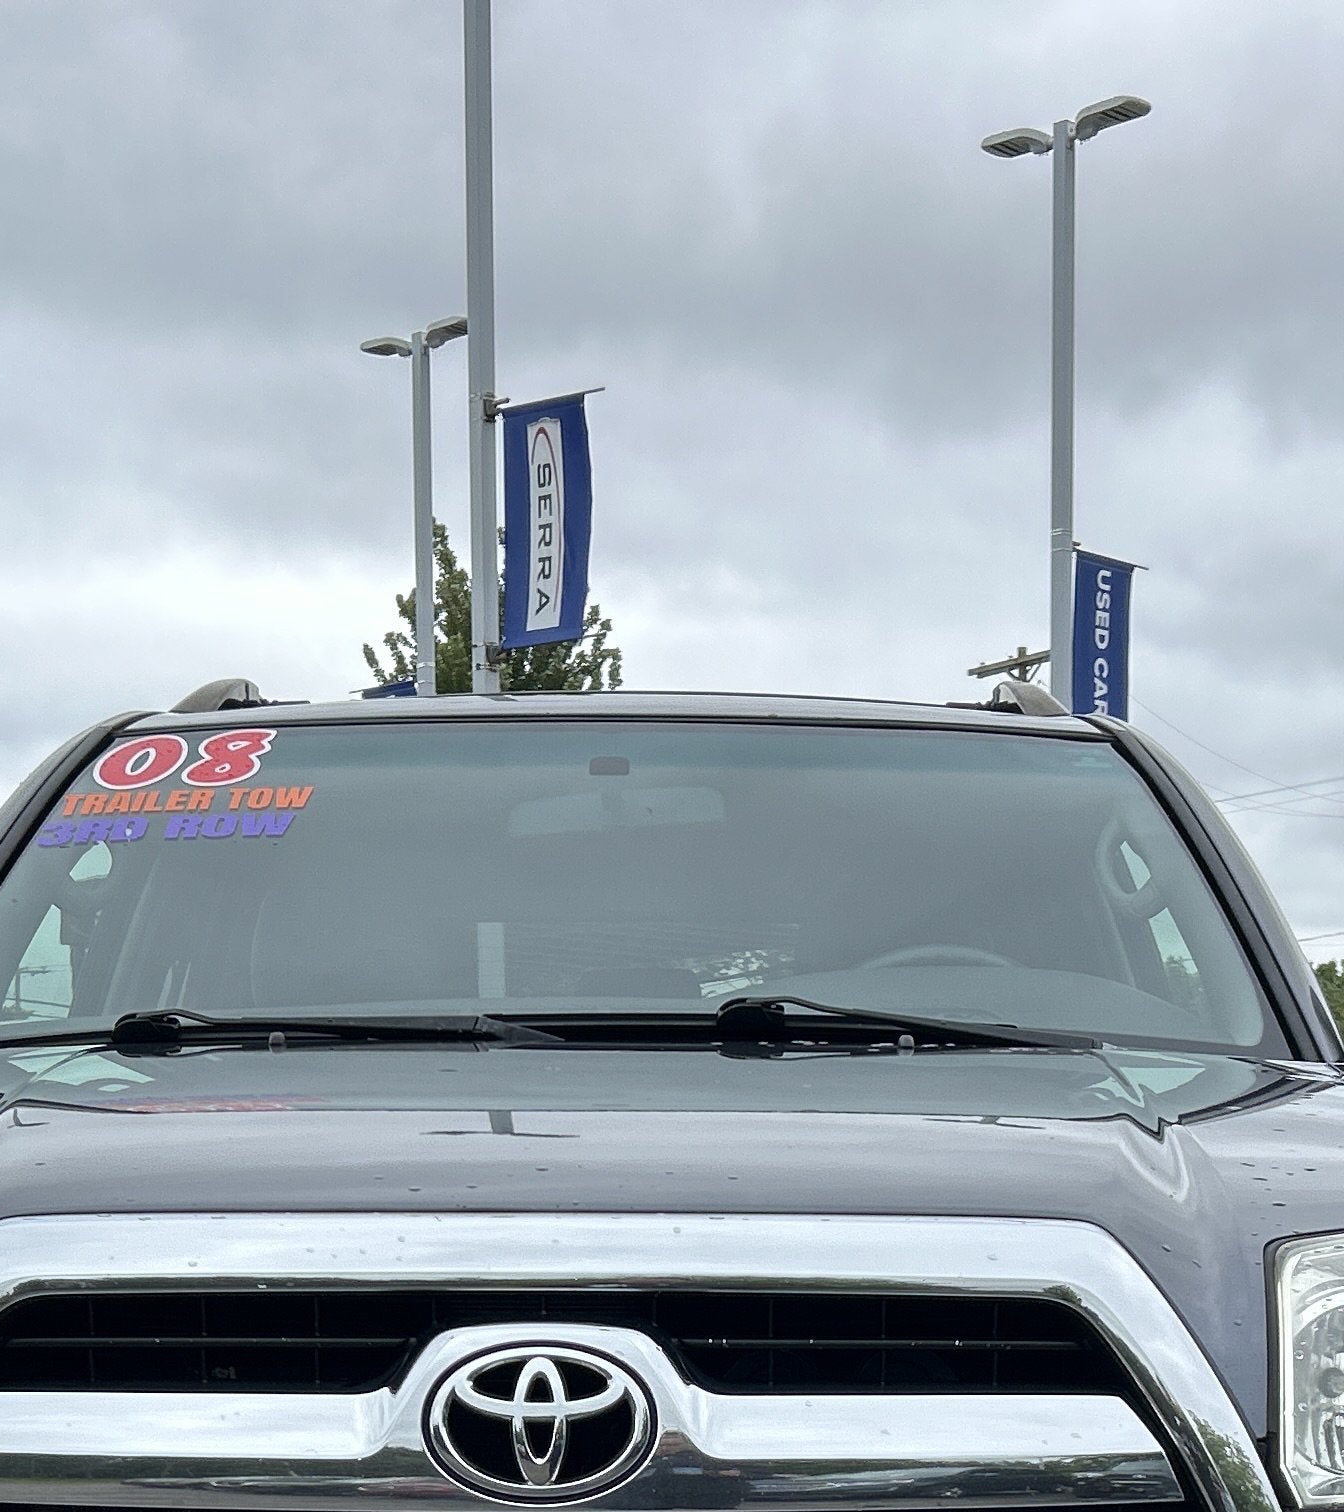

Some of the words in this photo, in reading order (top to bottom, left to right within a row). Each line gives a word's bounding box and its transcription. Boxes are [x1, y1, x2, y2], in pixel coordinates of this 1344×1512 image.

[536, 463, 552, 616] SERRA
[1095, 570, 1111, 649] USED
[93, 729, 277, 790] 08
[36, 816, 150, 847] 3RD
[164, 811, 297, 840] ROW
[63, 792, 215, 816] TRAILER
[229, 787, 314, 810] TOW
